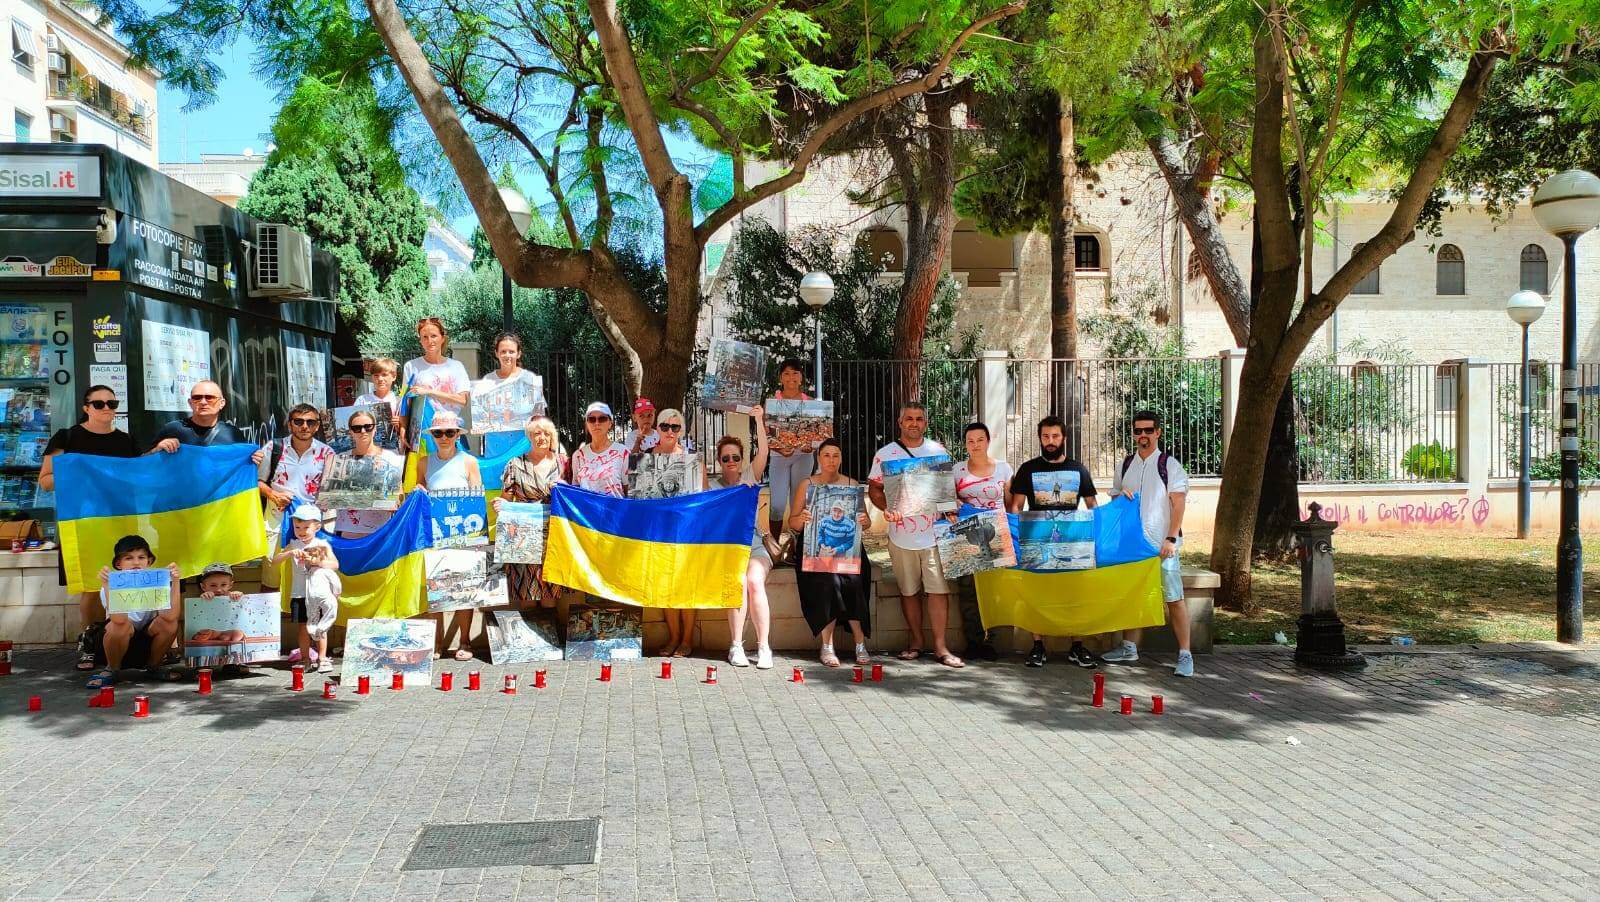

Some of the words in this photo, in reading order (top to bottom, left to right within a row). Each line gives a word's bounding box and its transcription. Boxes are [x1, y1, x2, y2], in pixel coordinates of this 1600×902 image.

[0, 169, 75, 188] Sisal.it
[133, 217, 183, 251] FOTOCOPIE
[188, 241, 203, 258] FAX
[134, 258, 194, 284] RACCOMANDATA
[139, 273, 164, 290] POSTA
[174, 283, 196, 298] POSTA
[196, 289, 202, 299] 4
[52, 311, 71, 386] FOTO
[117, 571, 162, 587] STOP
